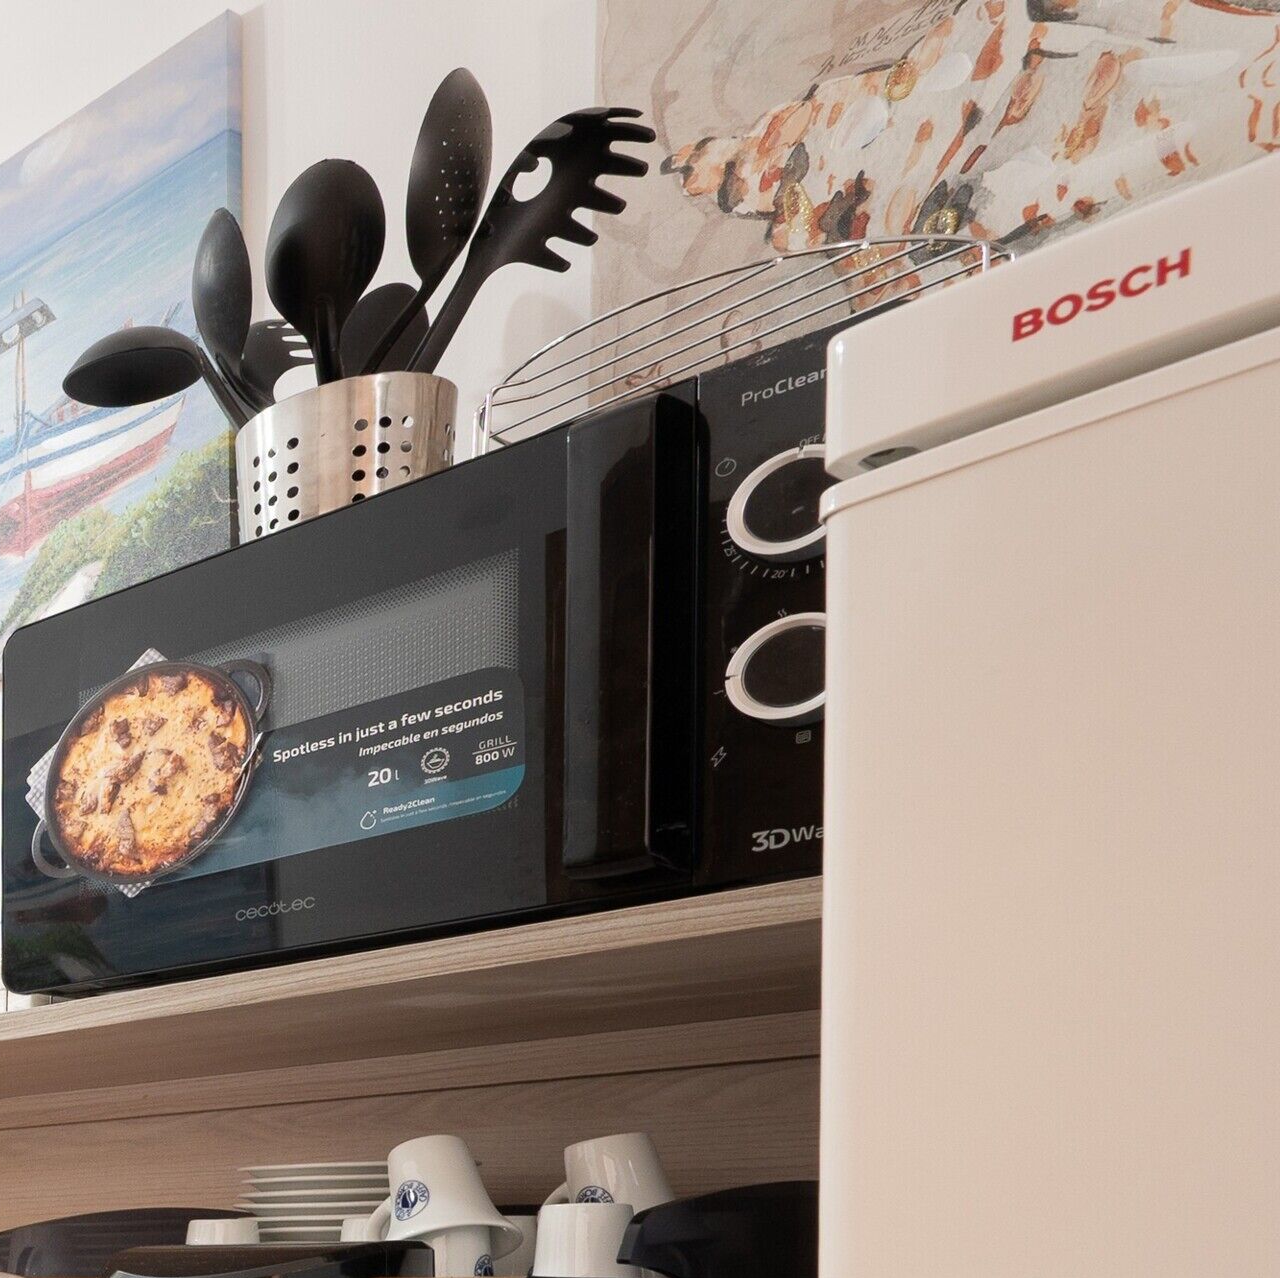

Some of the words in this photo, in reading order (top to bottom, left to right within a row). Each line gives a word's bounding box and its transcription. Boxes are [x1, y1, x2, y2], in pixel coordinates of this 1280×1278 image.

[1011, 246, 1192, 342] BOSCH
[273, 735, 336, 763] Spotless
[338, 731, 352, 745] in
[355, 721, 385, 742] just
[388, 719, 398, 730] a
[400, 708, 431, 727] few
[434, 689, 503, 717] seconds
[358, 734, 420, 758] Impecable
[423, 728, 439, 741] en
[441, 710, 504, 736] segundos
[478, 735, 512, 750] GRILL
[475, 750, 500, 766] 800
[502, 746, 516, 758] W
[367, 768, 392, 788] 20
[383, 796, 435, 815] Ready2Clean
[751, 825, 824, 852] 3DWa
[235, 897, 316, 921] cecotec
